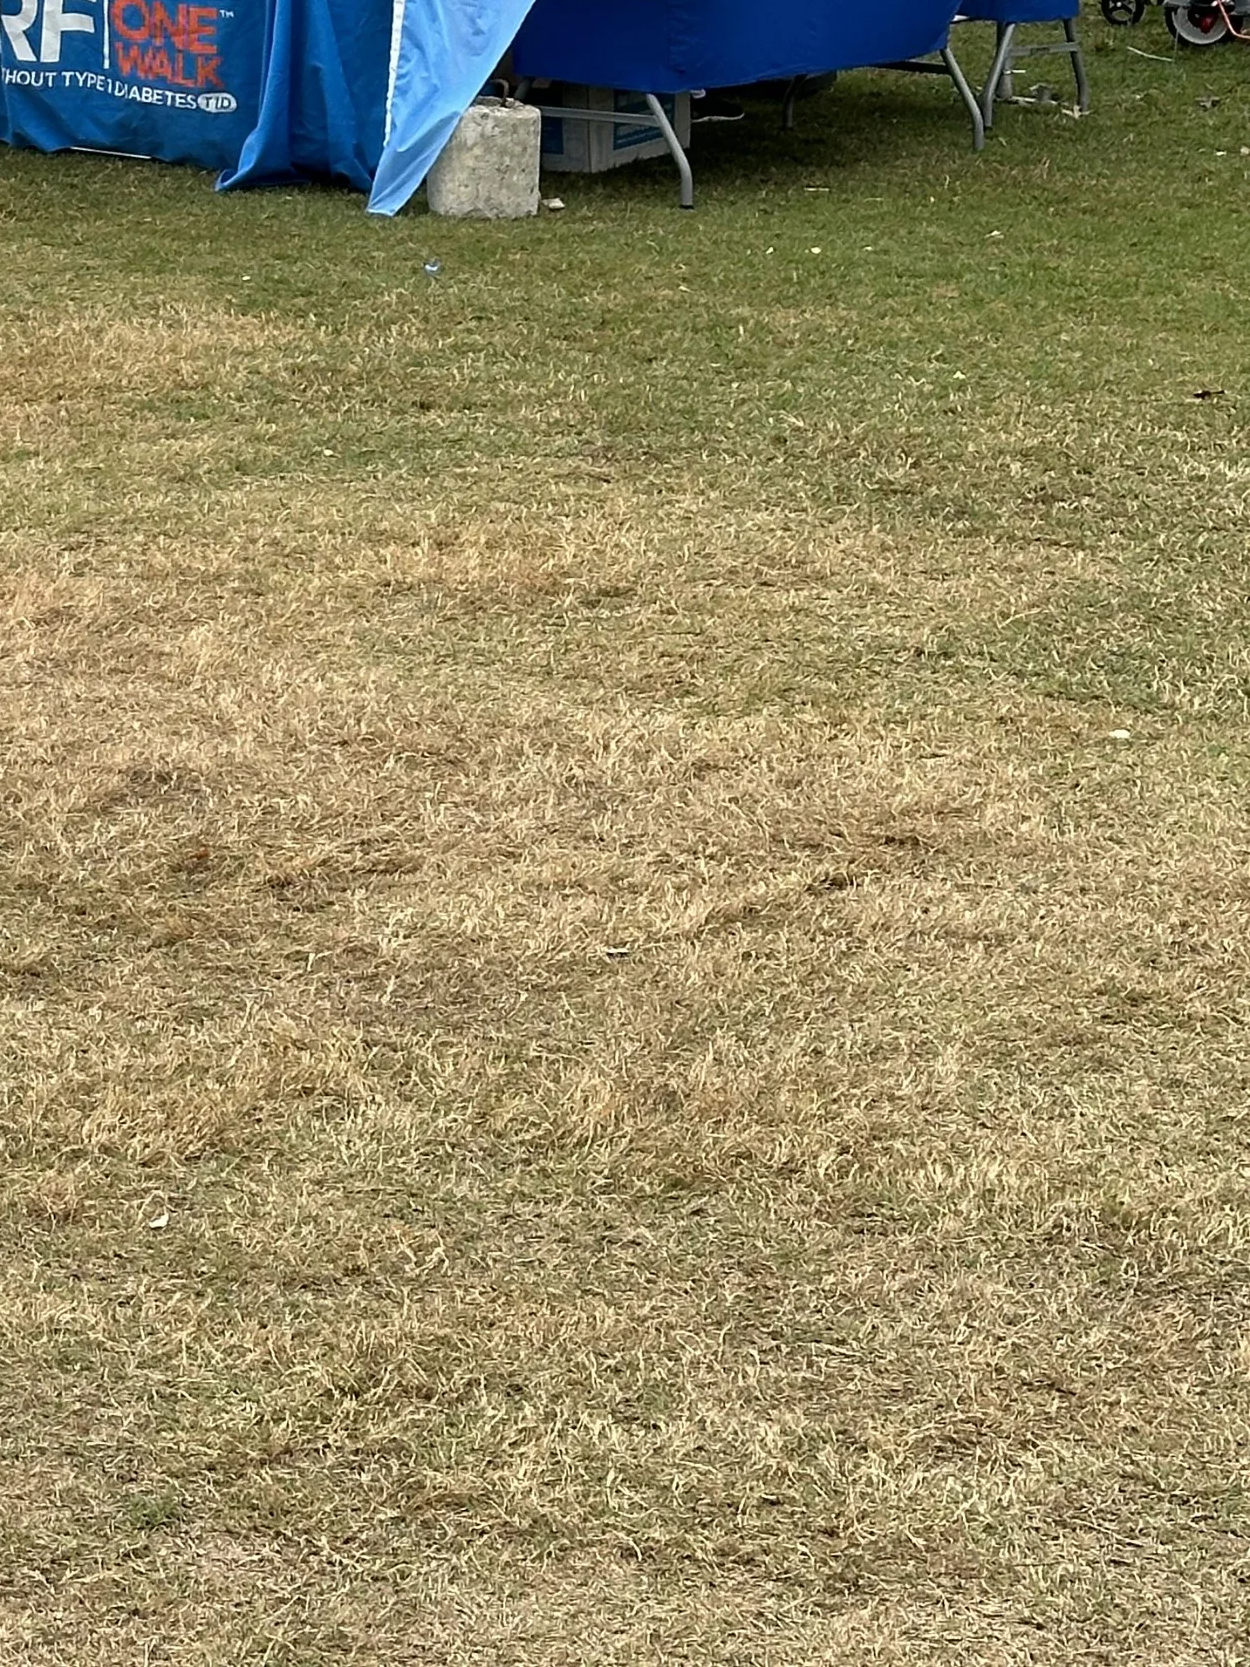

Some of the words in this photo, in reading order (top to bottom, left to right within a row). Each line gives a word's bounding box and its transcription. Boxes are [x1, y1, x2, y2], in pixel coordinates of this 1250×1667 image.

[115, 42, 225, 87] WALK
[2, 68, 56, 86] HOUT
[61, 71, 107, 92] TYPE
[114, 81, 198, 110] DIABETES
